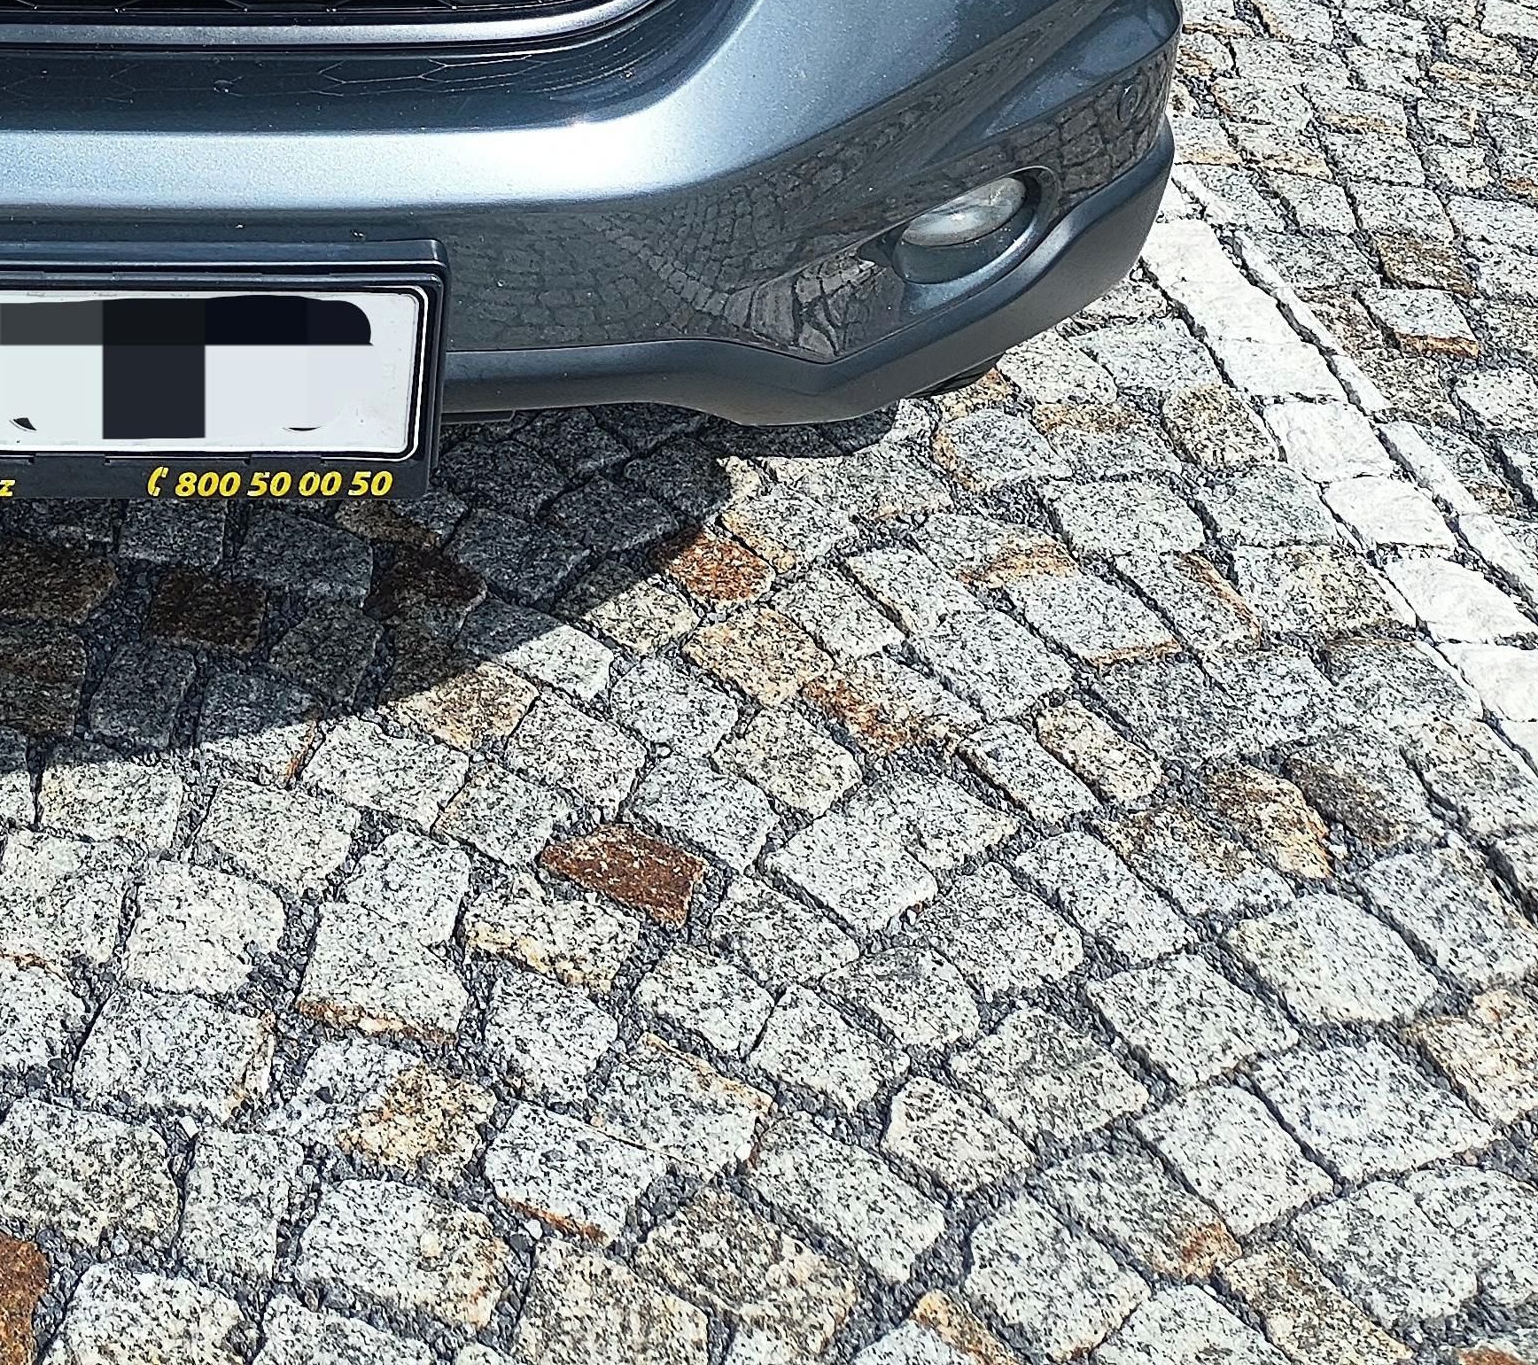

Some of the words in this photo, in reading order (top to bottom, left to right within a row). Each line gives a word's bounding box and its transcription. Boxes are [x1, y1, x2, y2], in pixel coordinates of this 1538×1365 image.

[175, 471, 241, 497] 800
[246, 471, 292, 497] 50
[298, 471, 342, 496] 00
[347, 470, 393, 496] 50
